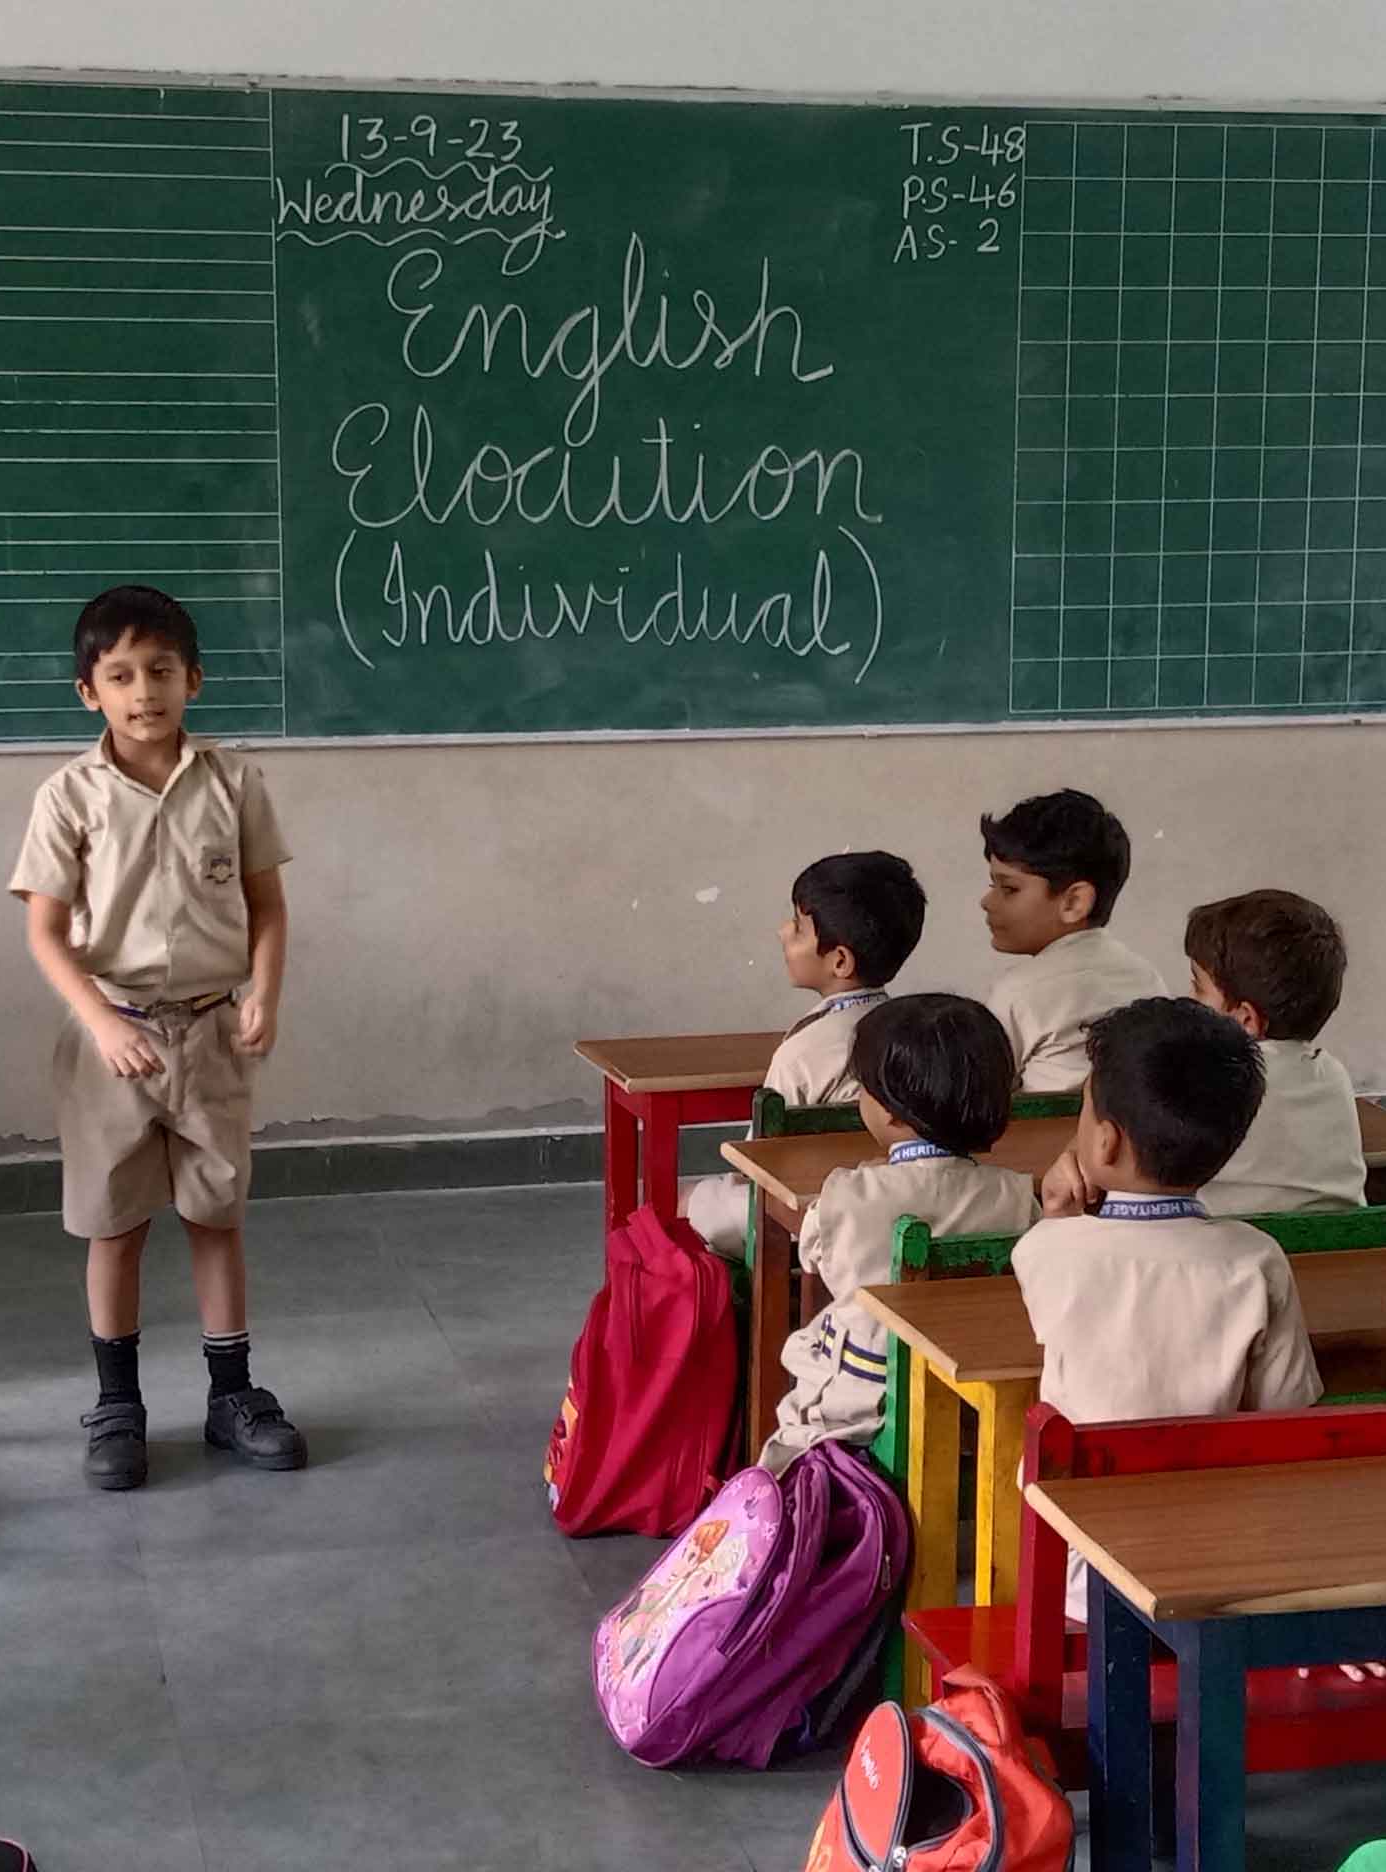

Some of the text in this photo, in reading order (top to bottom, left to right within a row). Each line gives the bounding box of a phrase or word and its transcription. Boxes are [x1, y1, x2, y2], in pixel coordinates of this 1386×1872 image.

[341, 113, 523, 161] 13-9-23
[276, 165, 554, 276] Wednesday
[387, 232, 834, 447] English
[332, 403, 882, 528] Elocution
[335, 526, 882, 684] (Individual)
